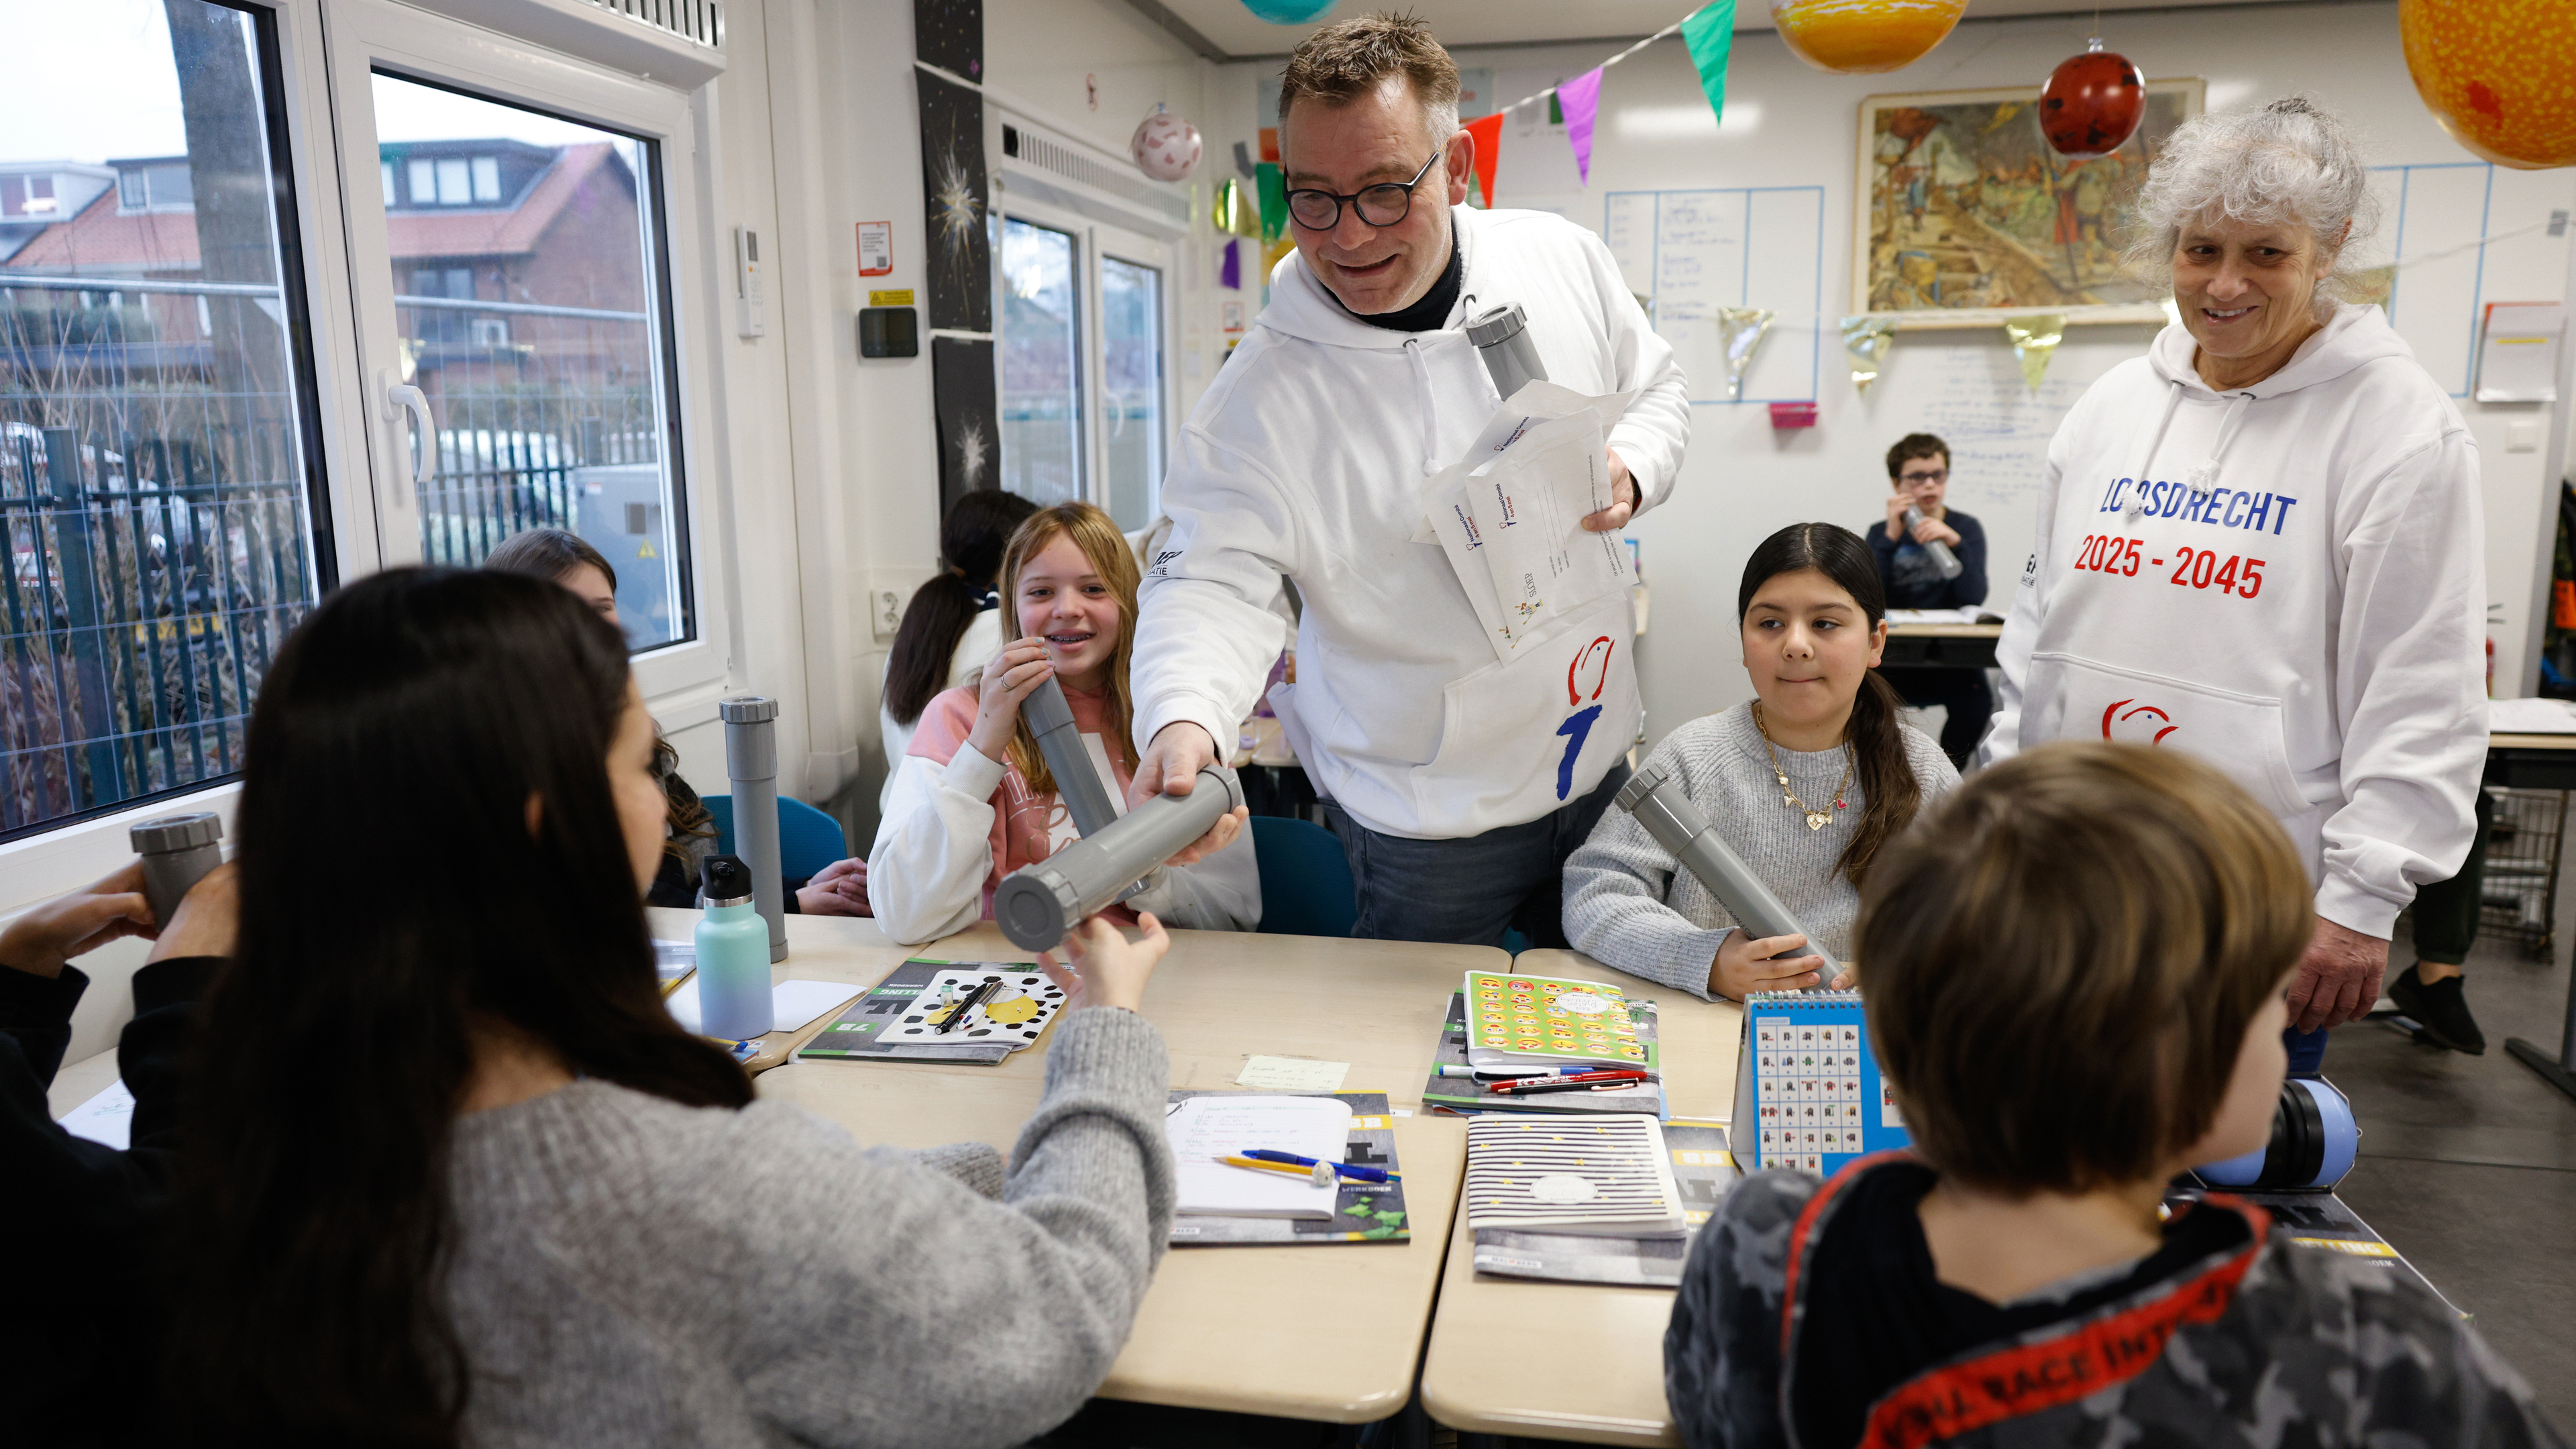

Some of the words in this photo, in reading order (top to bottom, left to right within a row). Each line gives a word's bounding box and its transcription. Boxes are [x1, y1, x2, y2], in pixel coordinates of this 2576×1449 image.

[1495, 483, 1503, 500] Comité
[1454, 504, 1464, 522] Comité
[1500, 500, 1509, 521] Nationaal
[1461, 520, 1474, 543] Nationaal
[2074, 534, 2144, 577] 2025
[2171, 546, 2266, 599] 2045
[1524, 572, 1538, 598] SLOEP
[1727, 909, 1742, 924] AAN
[835, 1023, 868, 1032] 7B
